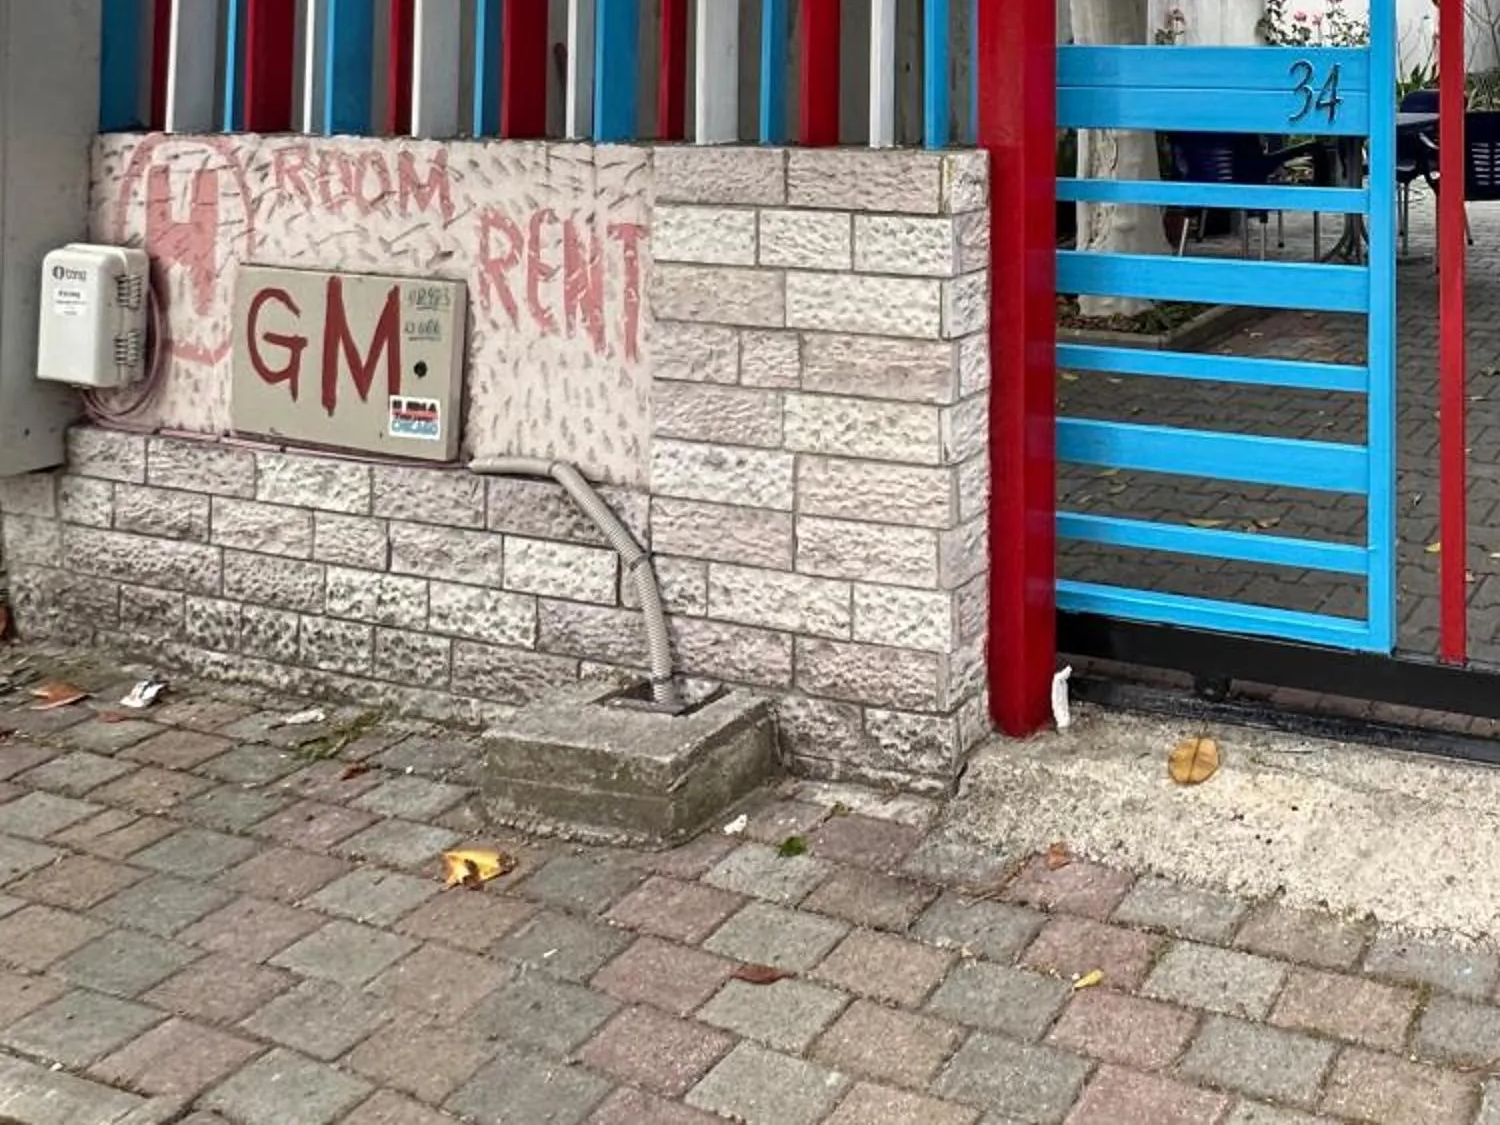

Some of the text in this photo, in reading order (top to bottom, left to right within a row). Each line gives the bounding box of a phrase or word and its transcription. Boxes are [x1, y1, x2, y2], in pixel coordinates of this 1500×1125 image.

[1287, 59, 1344, 124] 34
[271, 142, 456, 222] ROOM
[476, 206, 650, 365] RENT
[246, 274, 401, 418] GM
